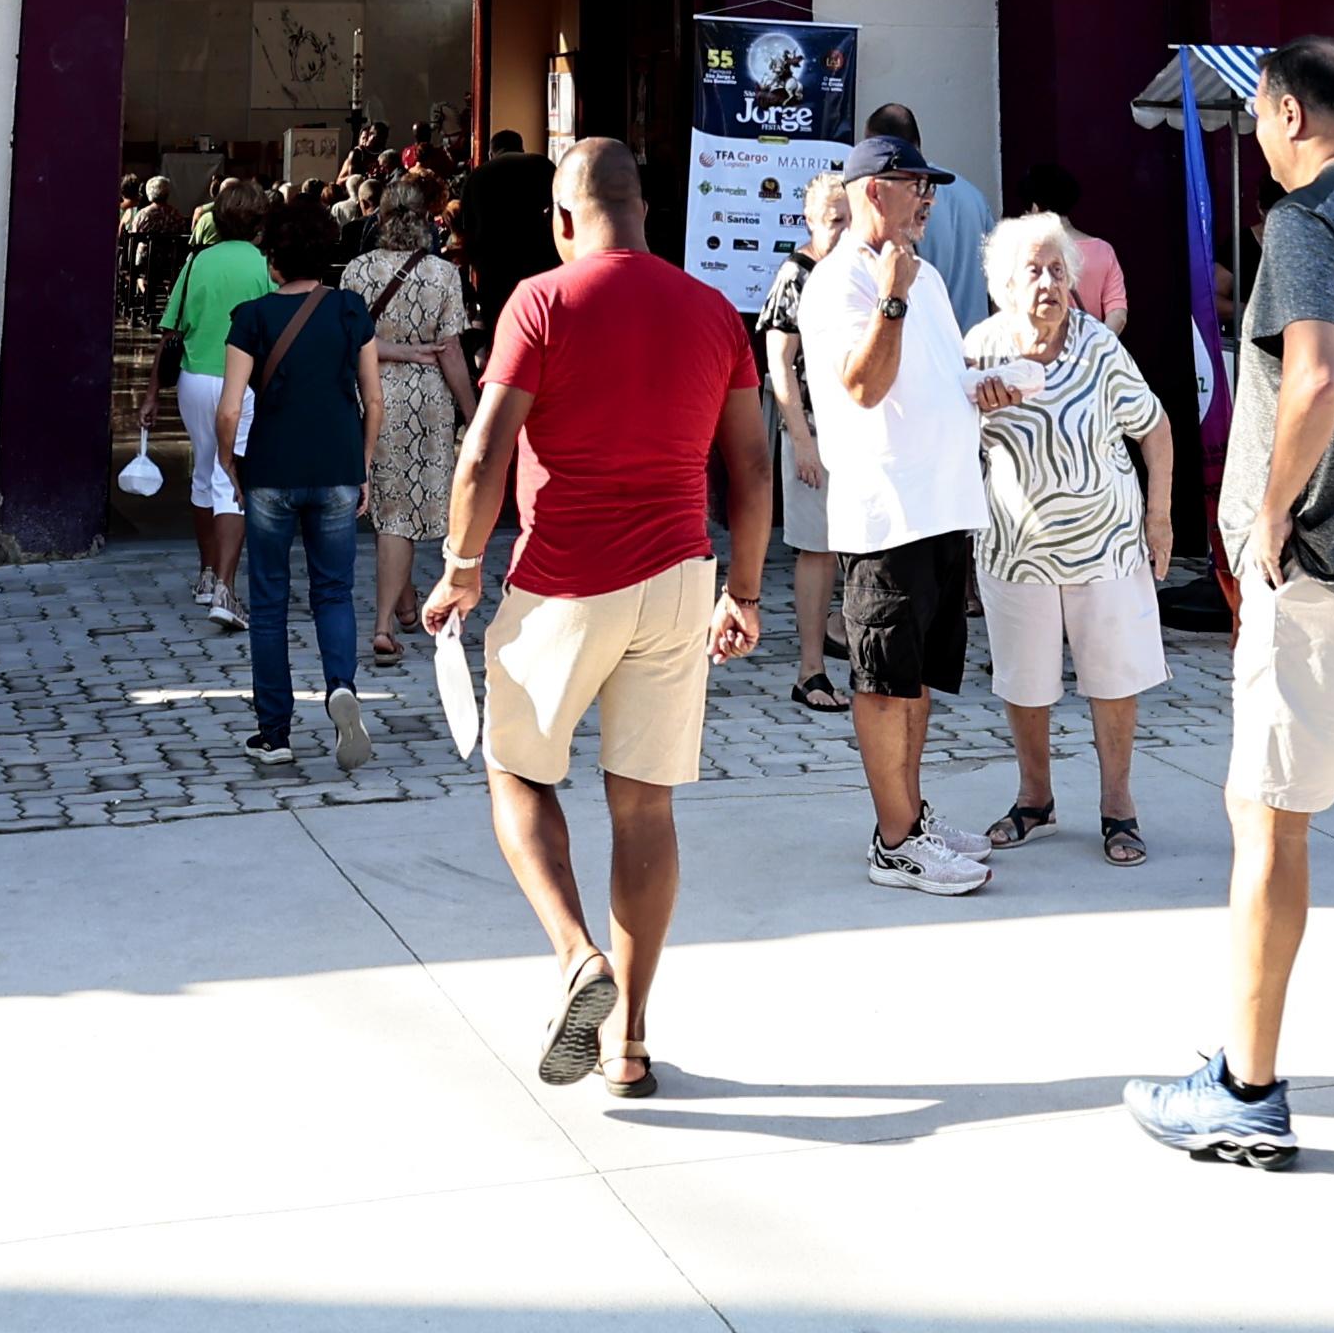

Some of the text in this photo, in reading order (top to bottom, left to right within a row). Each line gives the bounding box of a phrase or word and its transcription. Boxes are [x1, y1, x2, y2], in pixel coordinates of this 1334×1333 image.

[708, 49, 734, 69] 55
[736, 97, 813, 132] Jorge
[761, 123, 781, 131] FESTA
[715, 150, 768, 165] TFA Cargo
[778, 156, 829, 170] MATRIZ
[727, 215, 761, 225] Santos
